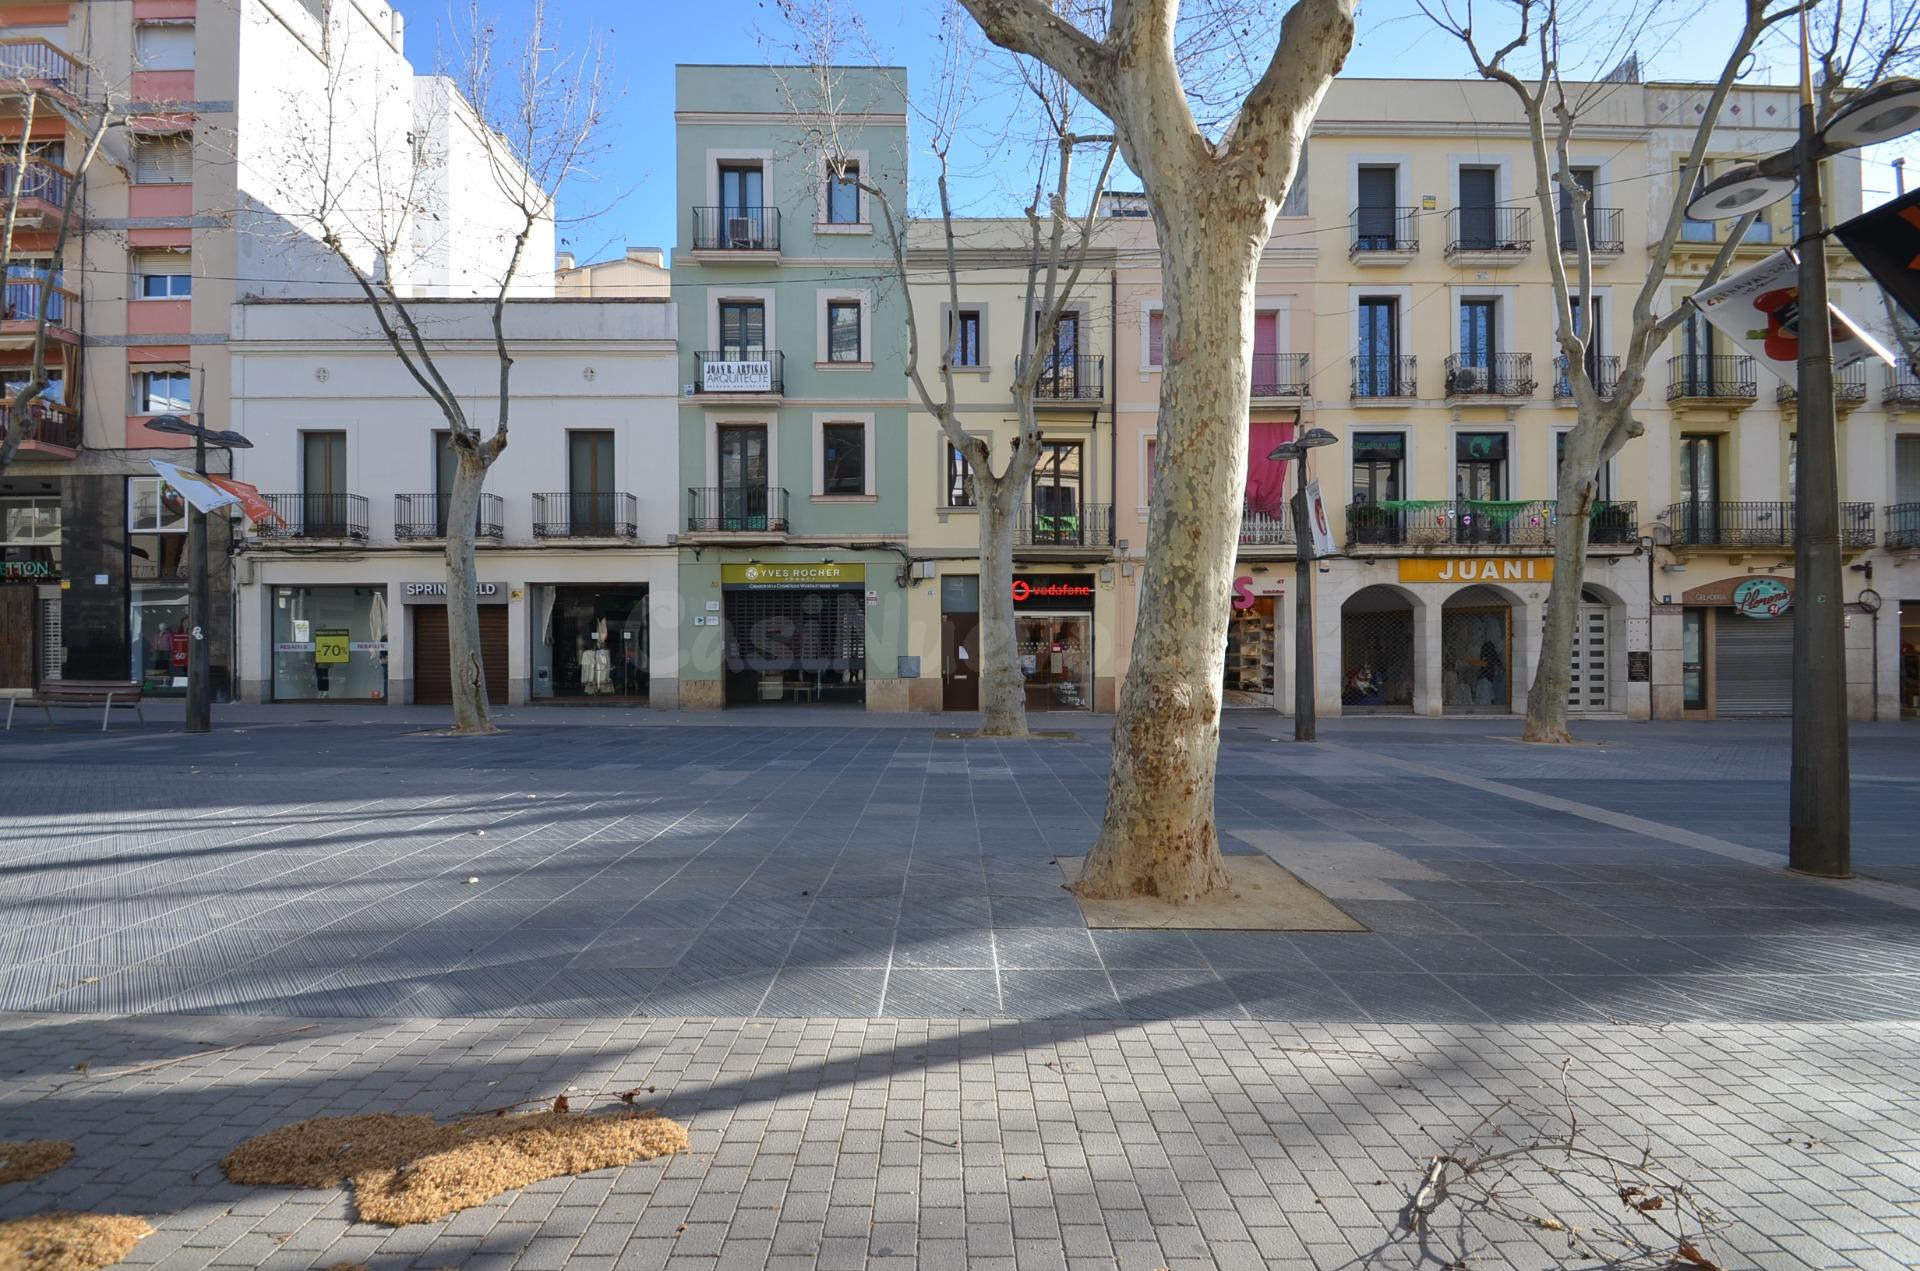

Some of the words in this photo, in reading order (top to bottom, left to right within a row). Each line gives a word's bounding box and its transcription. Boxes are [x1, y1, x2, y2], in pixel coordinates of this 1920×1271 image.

[706, 364, 725, 375] JOAN
[737, 363, 769, 375] ARTIGAS
[706, 373, 769, 384] ARQUITECTE
[761, 569, 789, 577] YVES
[793, 569, 841, 577] ROCHER
[1438, 560, 1535, 580] JUANI
[407, 584, 497, 596] SPRINELD
[1033, 584, 1090, 596] vodafone
